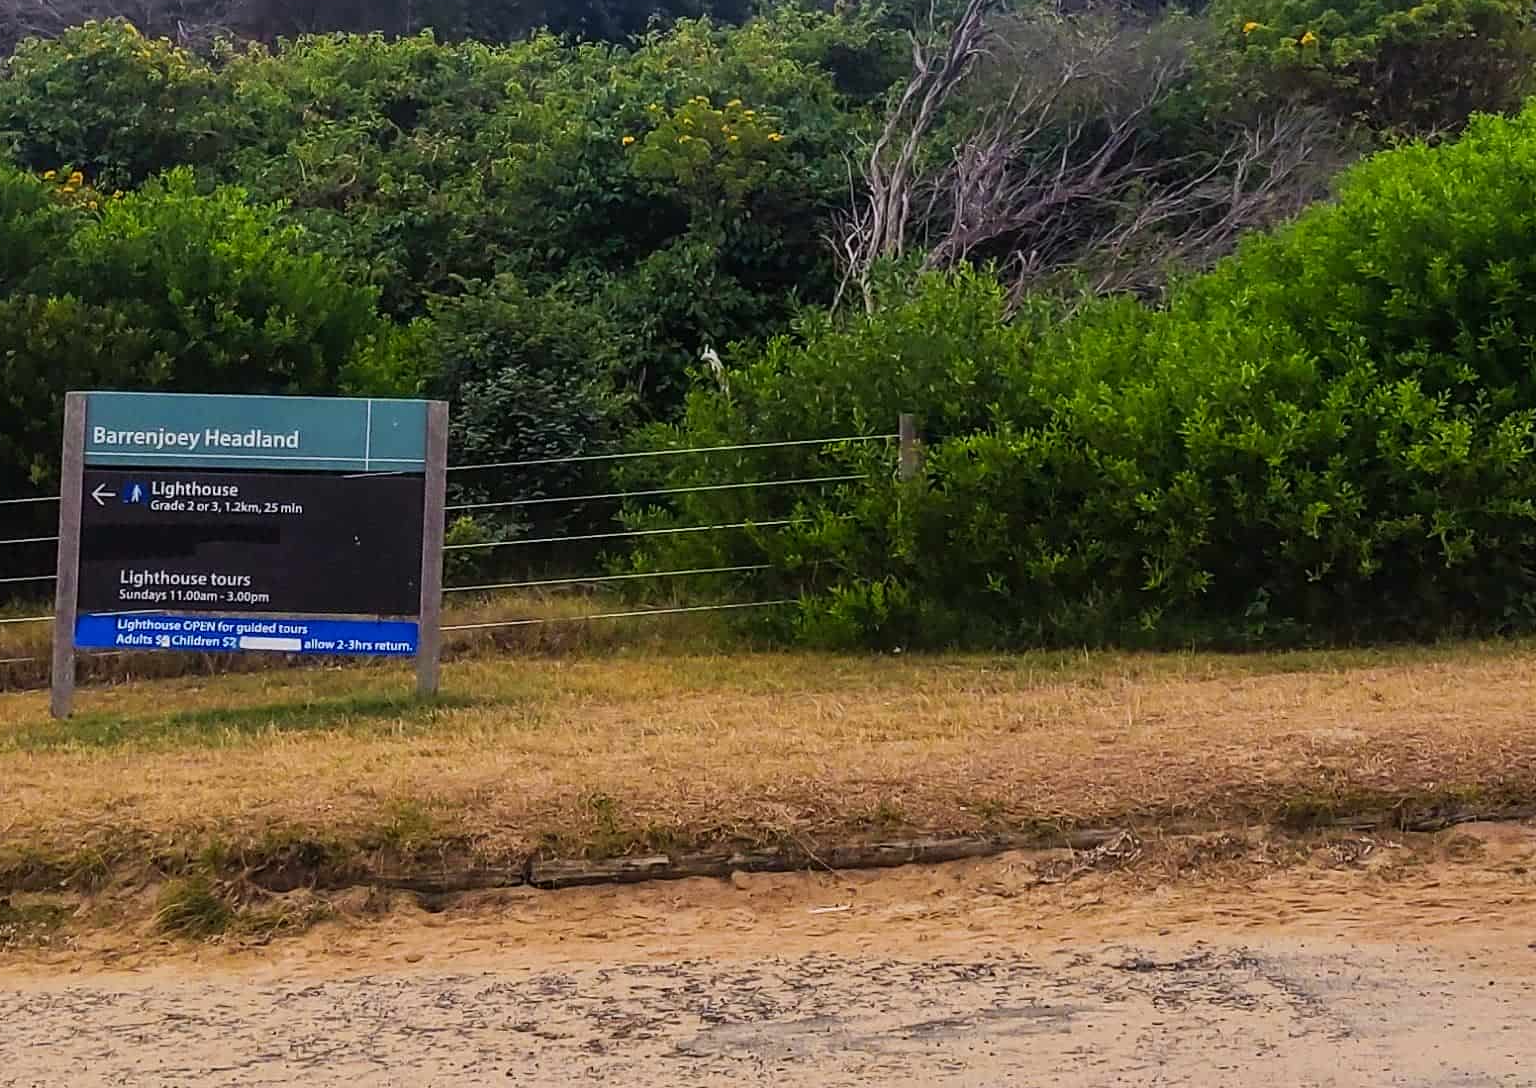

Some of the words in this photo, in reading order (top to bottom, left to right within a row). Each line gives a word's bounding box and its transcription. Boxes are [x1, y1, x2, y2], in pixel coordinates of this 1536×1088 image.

[93, 426, 200, 450] Barrenjoey
[204, 429, 299, 449] Headland
[151, 481, 239, 498] Lighthouse
[150, 500, 184, 512] Grade
[187, 501, 194, 512] 2
[196, 504, 209, 513] or
[211, 502, 222, 514] 3,
[224, 502, 262, 516] 1.2km,
[263, 503, 279, 514] 25
[280, 503, 303, 515] min
[120, 570, 207, 587] Lighthouse
[211, 573, 251, 587] tours
[119, 588, 167, 603] Sundays
[169, 590, 218, 602] 11.00am
[226, 591, 270, 605] 3.00pm
[117, 618, 182, 632] Lighthouse
[183, 620, 216, 632] OPEN
[217, 621, 234, 633] for
[236, 622, 277, 635] guided
[278, 623, 308, 635] tours
[116, 633, 153, 645] Adults
[171, 634, 221, 647] Children
[304, 638, 335, 650] allow
[336, 639, 373, 651] 2-3hrs
[374, 641, 413, 652] return.
